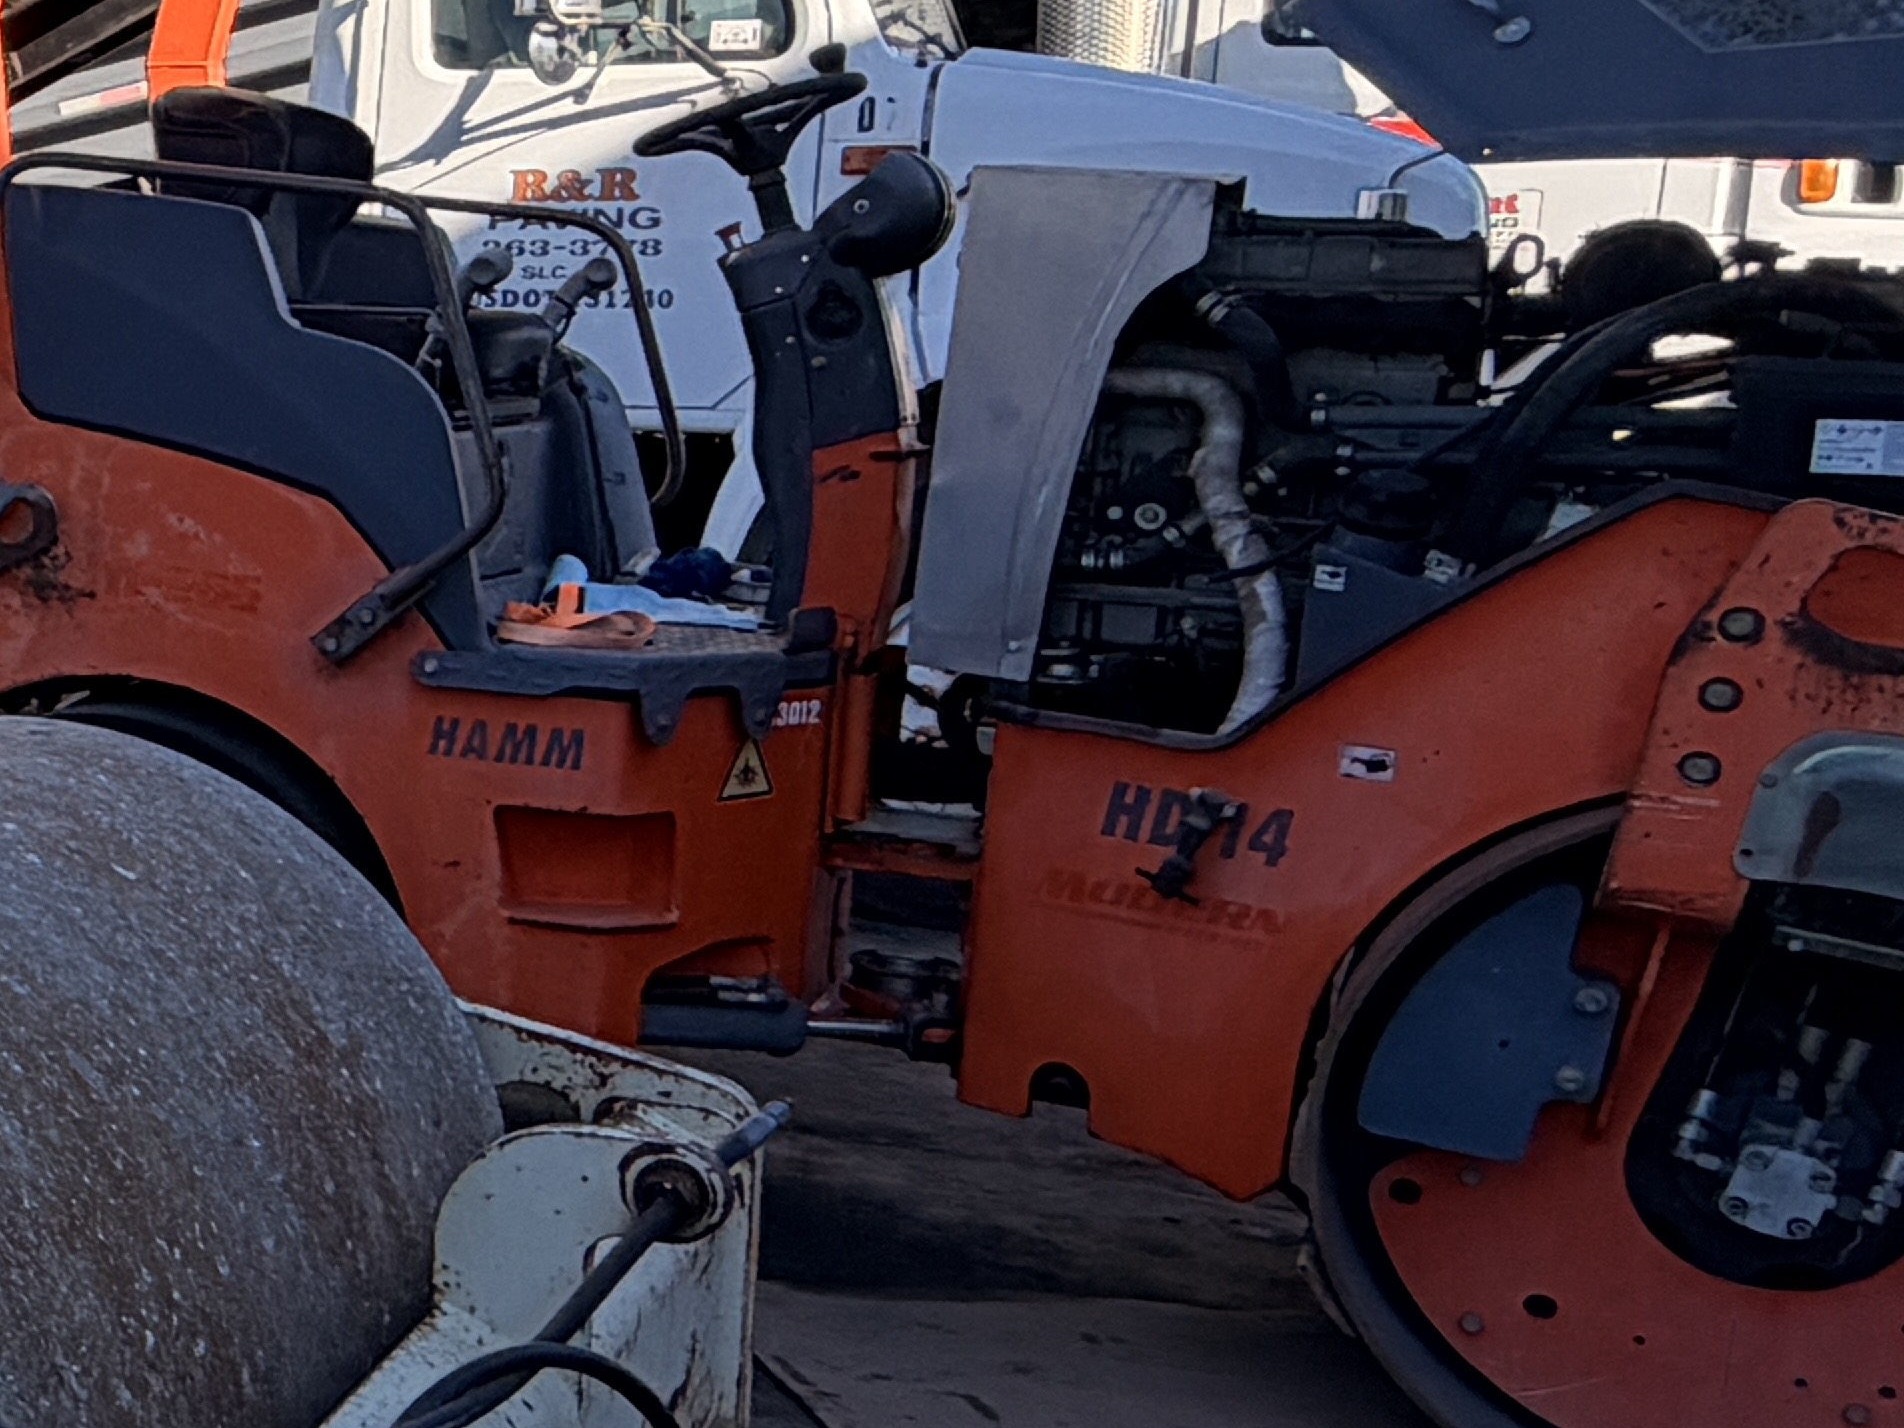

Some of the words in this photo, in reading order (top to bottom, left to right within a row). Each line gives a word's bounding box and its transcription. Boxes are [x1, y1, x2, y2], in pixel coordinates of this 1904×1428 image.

[509, 166, 641, 204] R&R
[520, 264, 568, 280] SLC
[427, 714, 585, 771] HAMM
[1100, 780, 1192, 848] HD
